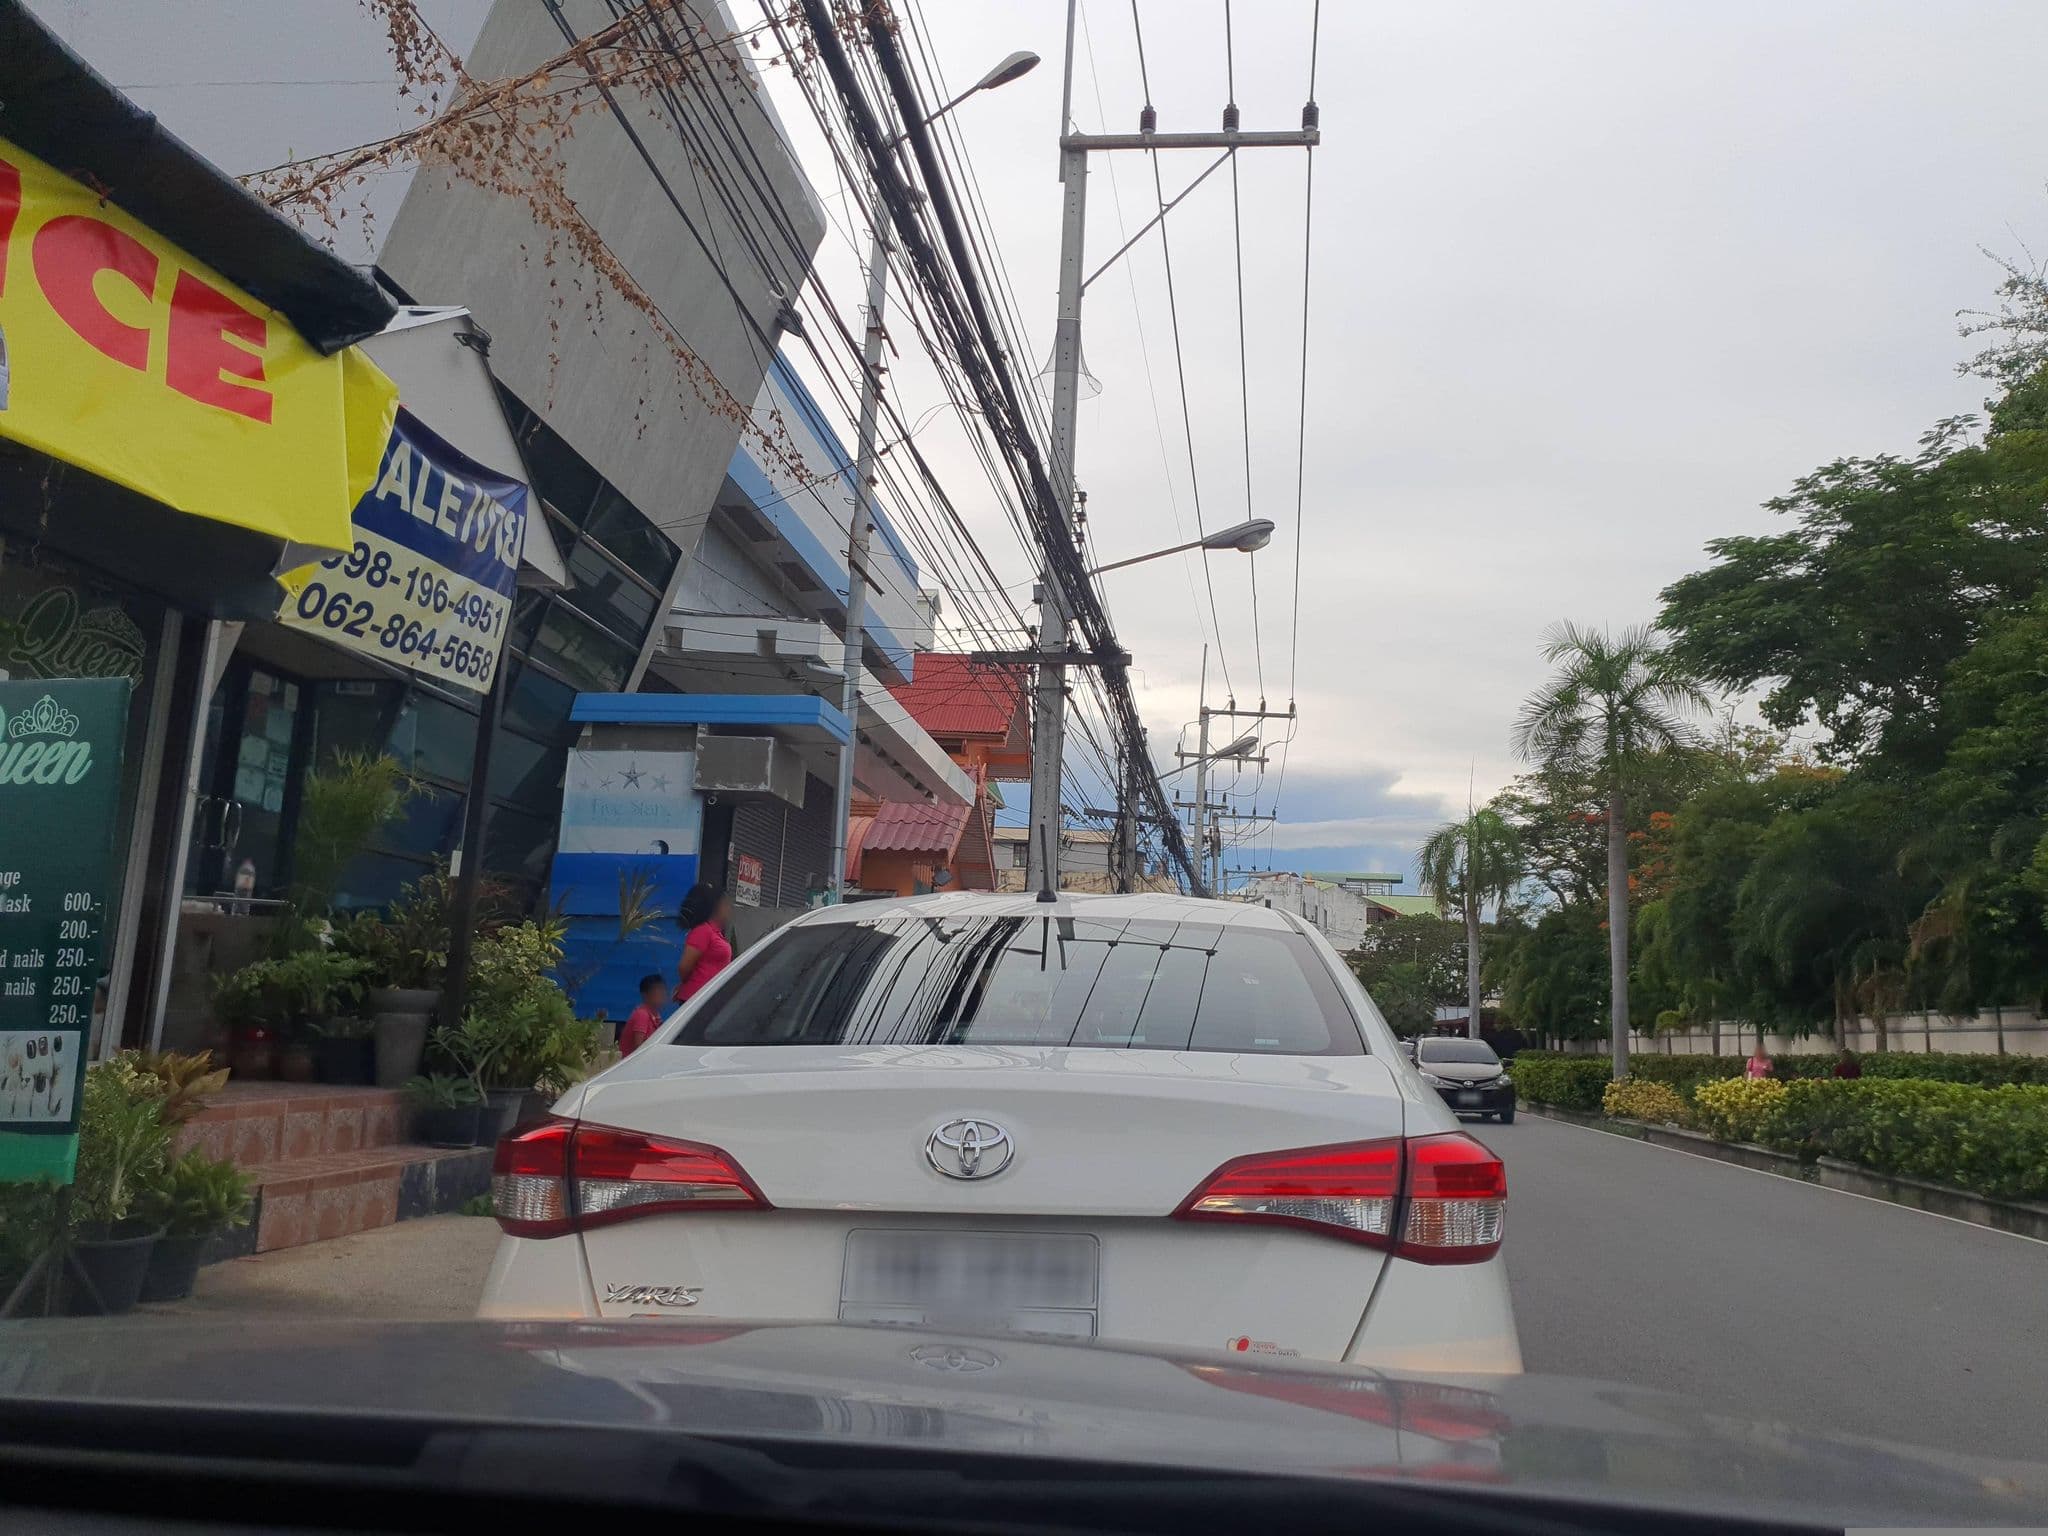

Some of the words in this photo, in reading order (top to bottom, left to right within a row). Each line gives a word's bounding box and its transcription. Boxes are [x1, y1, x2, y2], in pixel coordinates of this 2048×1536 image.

[297, 582, 494, 683] 062-864-5658
[0, 704, 93, 785] ueen
[64, 892, 102, 912] 600.-
[60, 920, 98, 939] 200.-
[13, 948, 45, 968] nails
[56, 947, 95, 967] 250.-
[5, 977, 36, 996] nails
[52, 976, 91, 995] 250.-
[49, 1004, 88, 1024] 250.-
[603, 1283, 704, 1307] YARIS
